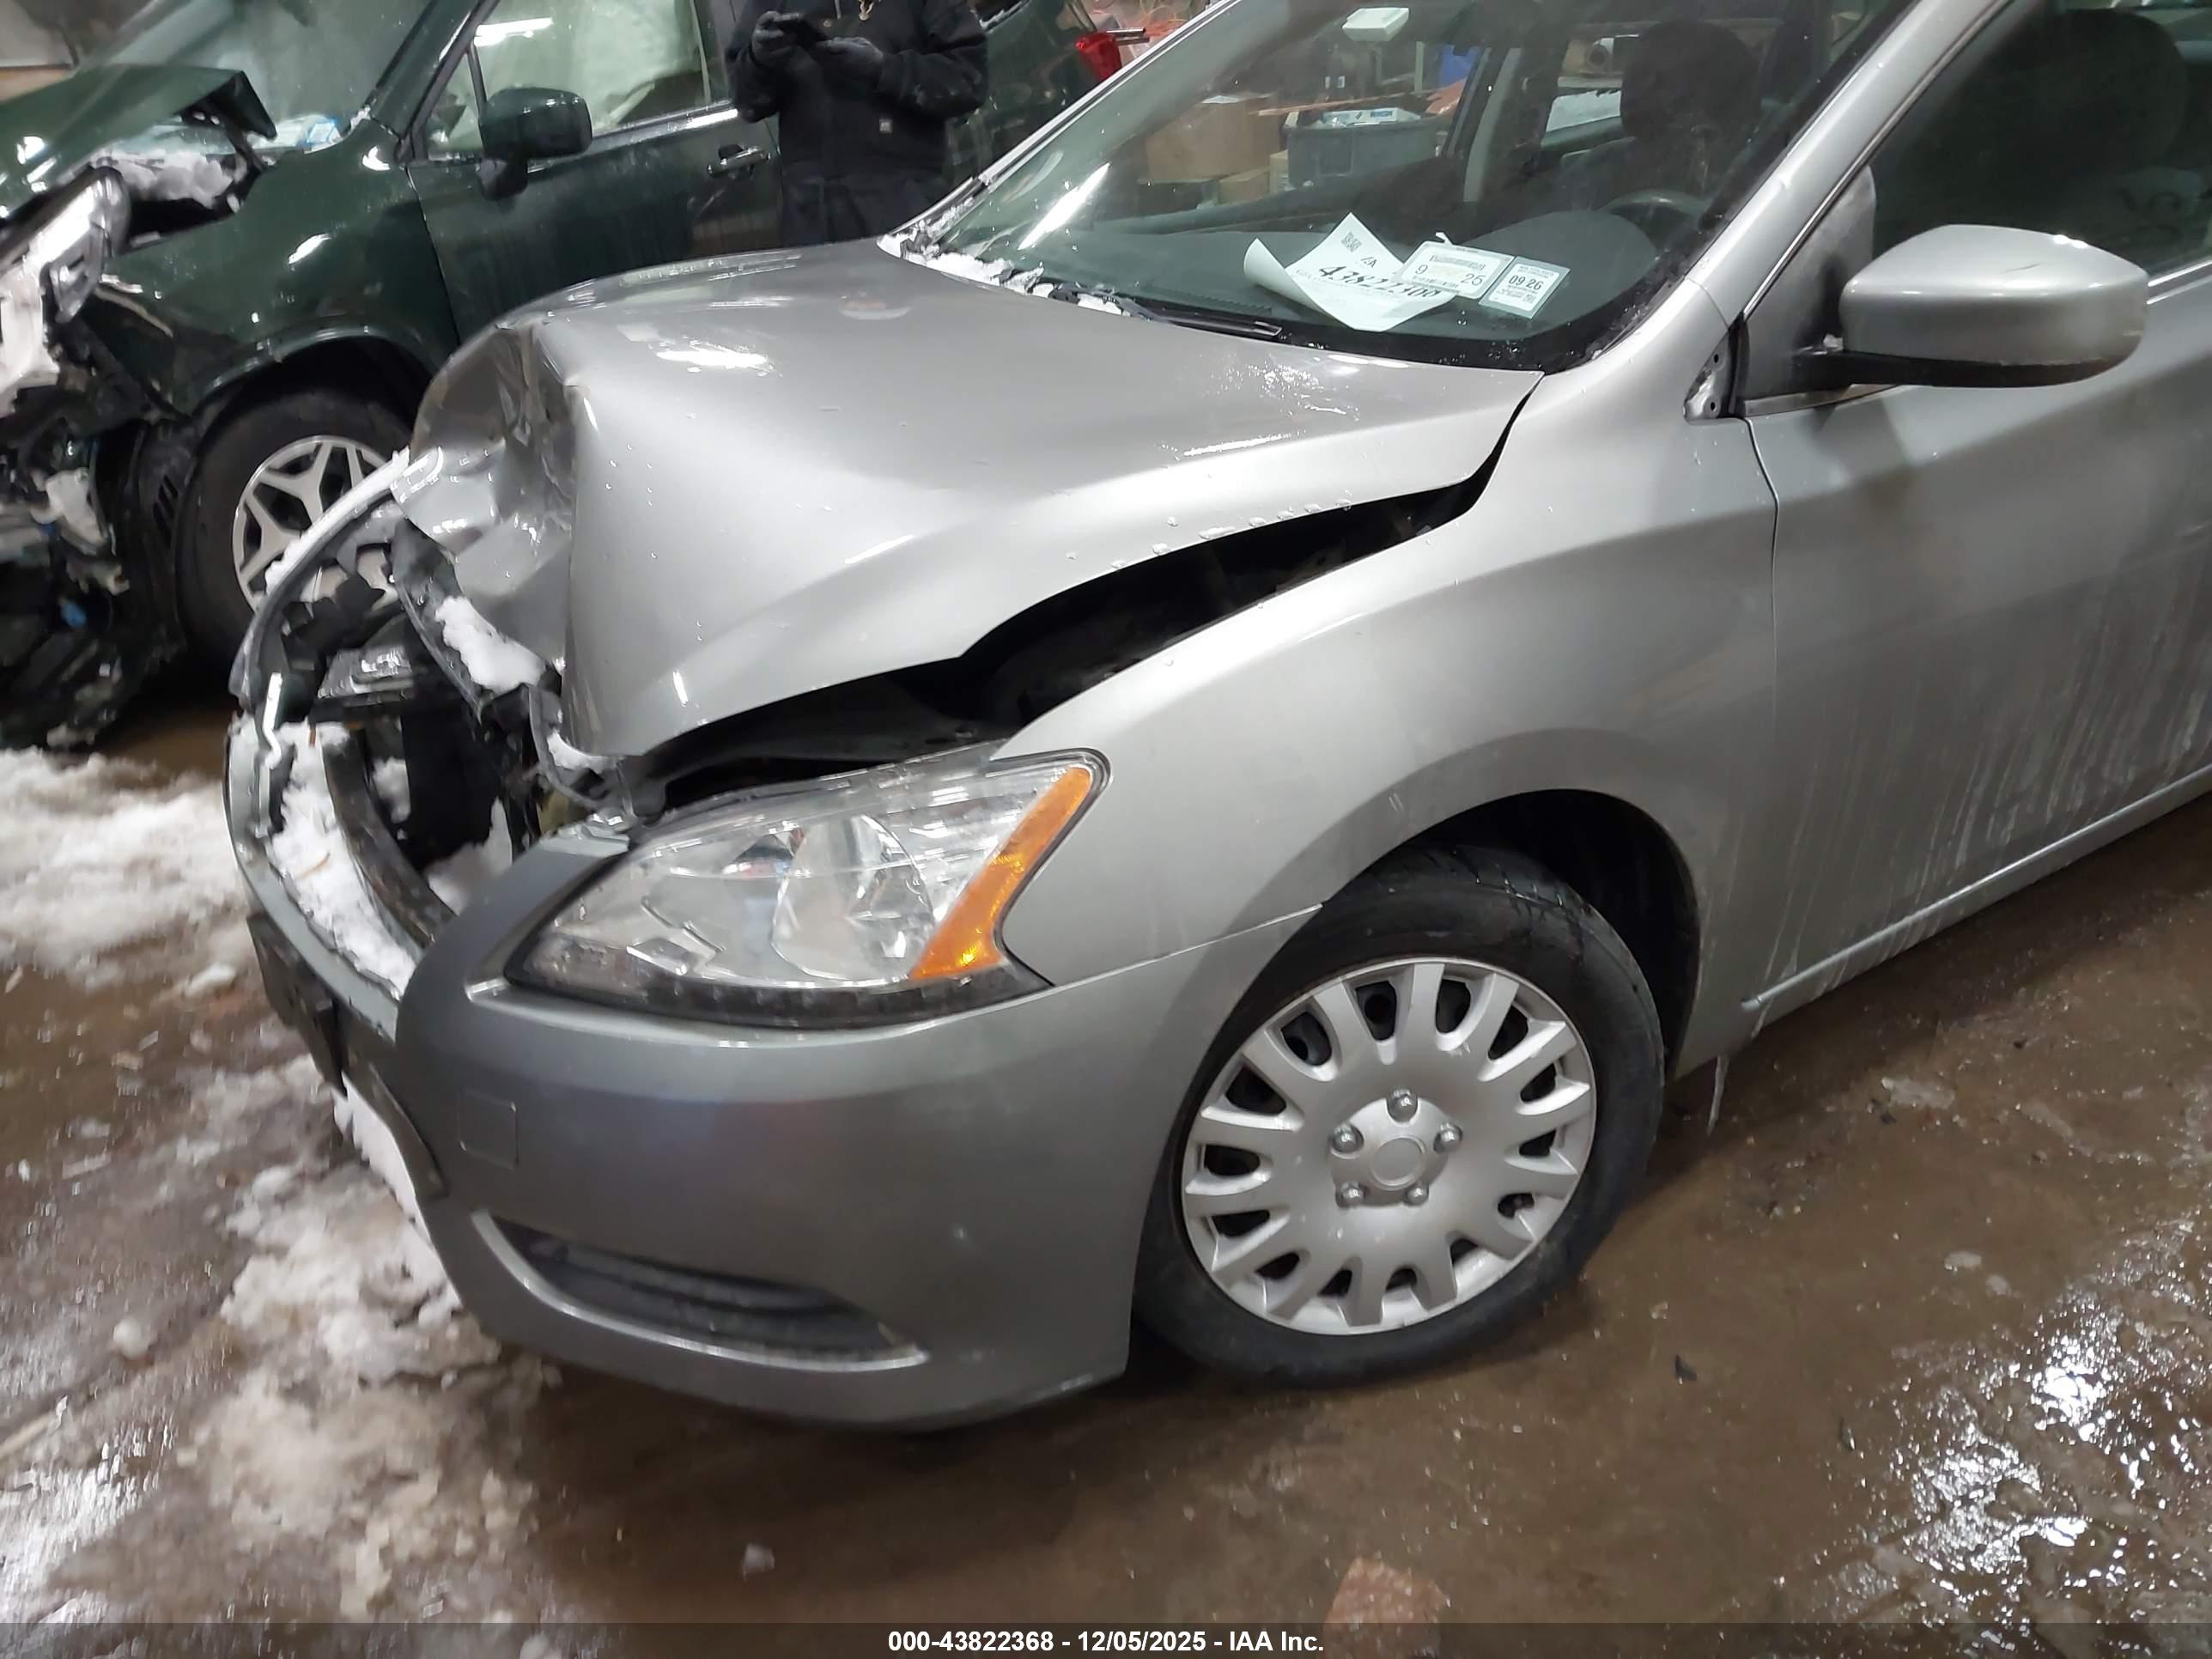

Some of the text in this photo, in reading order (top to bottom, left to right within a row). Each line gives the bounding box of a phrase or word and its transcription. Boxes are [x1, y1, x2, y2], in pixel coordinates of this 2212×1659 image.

[1414, 264, 1429, 276] 9
[1460, 272, 1486, 287] 25
[1508, 275, 1545, 290] 09 26
